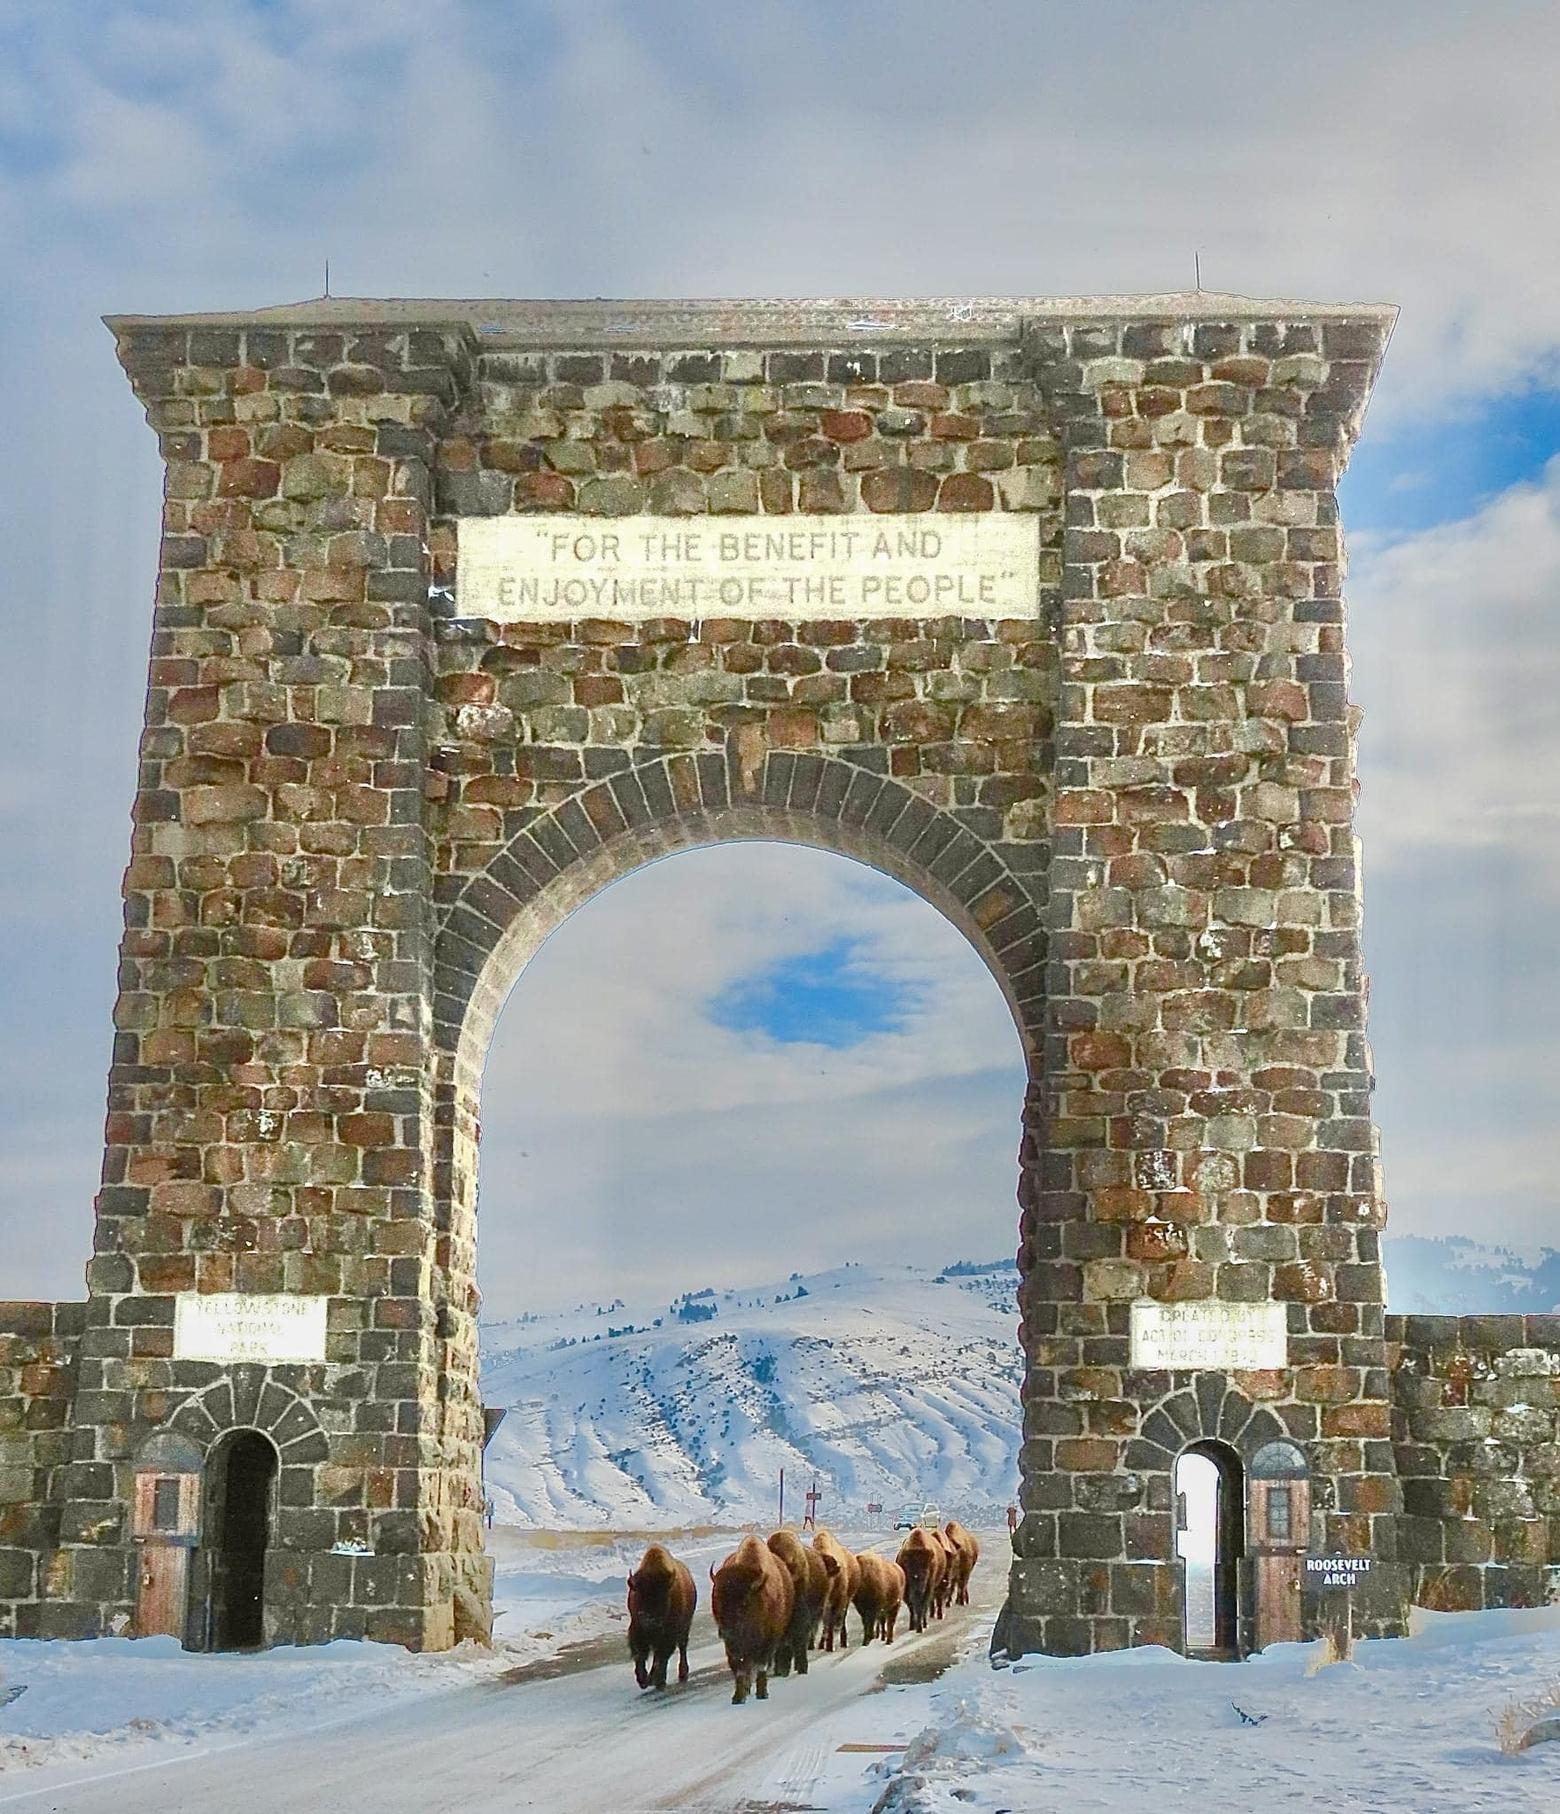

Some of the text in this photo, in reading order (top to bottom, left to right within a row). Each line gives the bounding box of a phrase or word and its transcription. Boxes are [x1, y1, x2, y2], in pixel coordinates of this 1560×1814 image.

[536, 529, 942, 562] "FOR THE BENEFIT AND
[498, 572, 1015, 606] ENJOYMENT OF THE PEOPLE"
[1306, 1559, 1371, 1571] ROOSEVELT
[1323, 1573, 1356, 1585] ARCH
